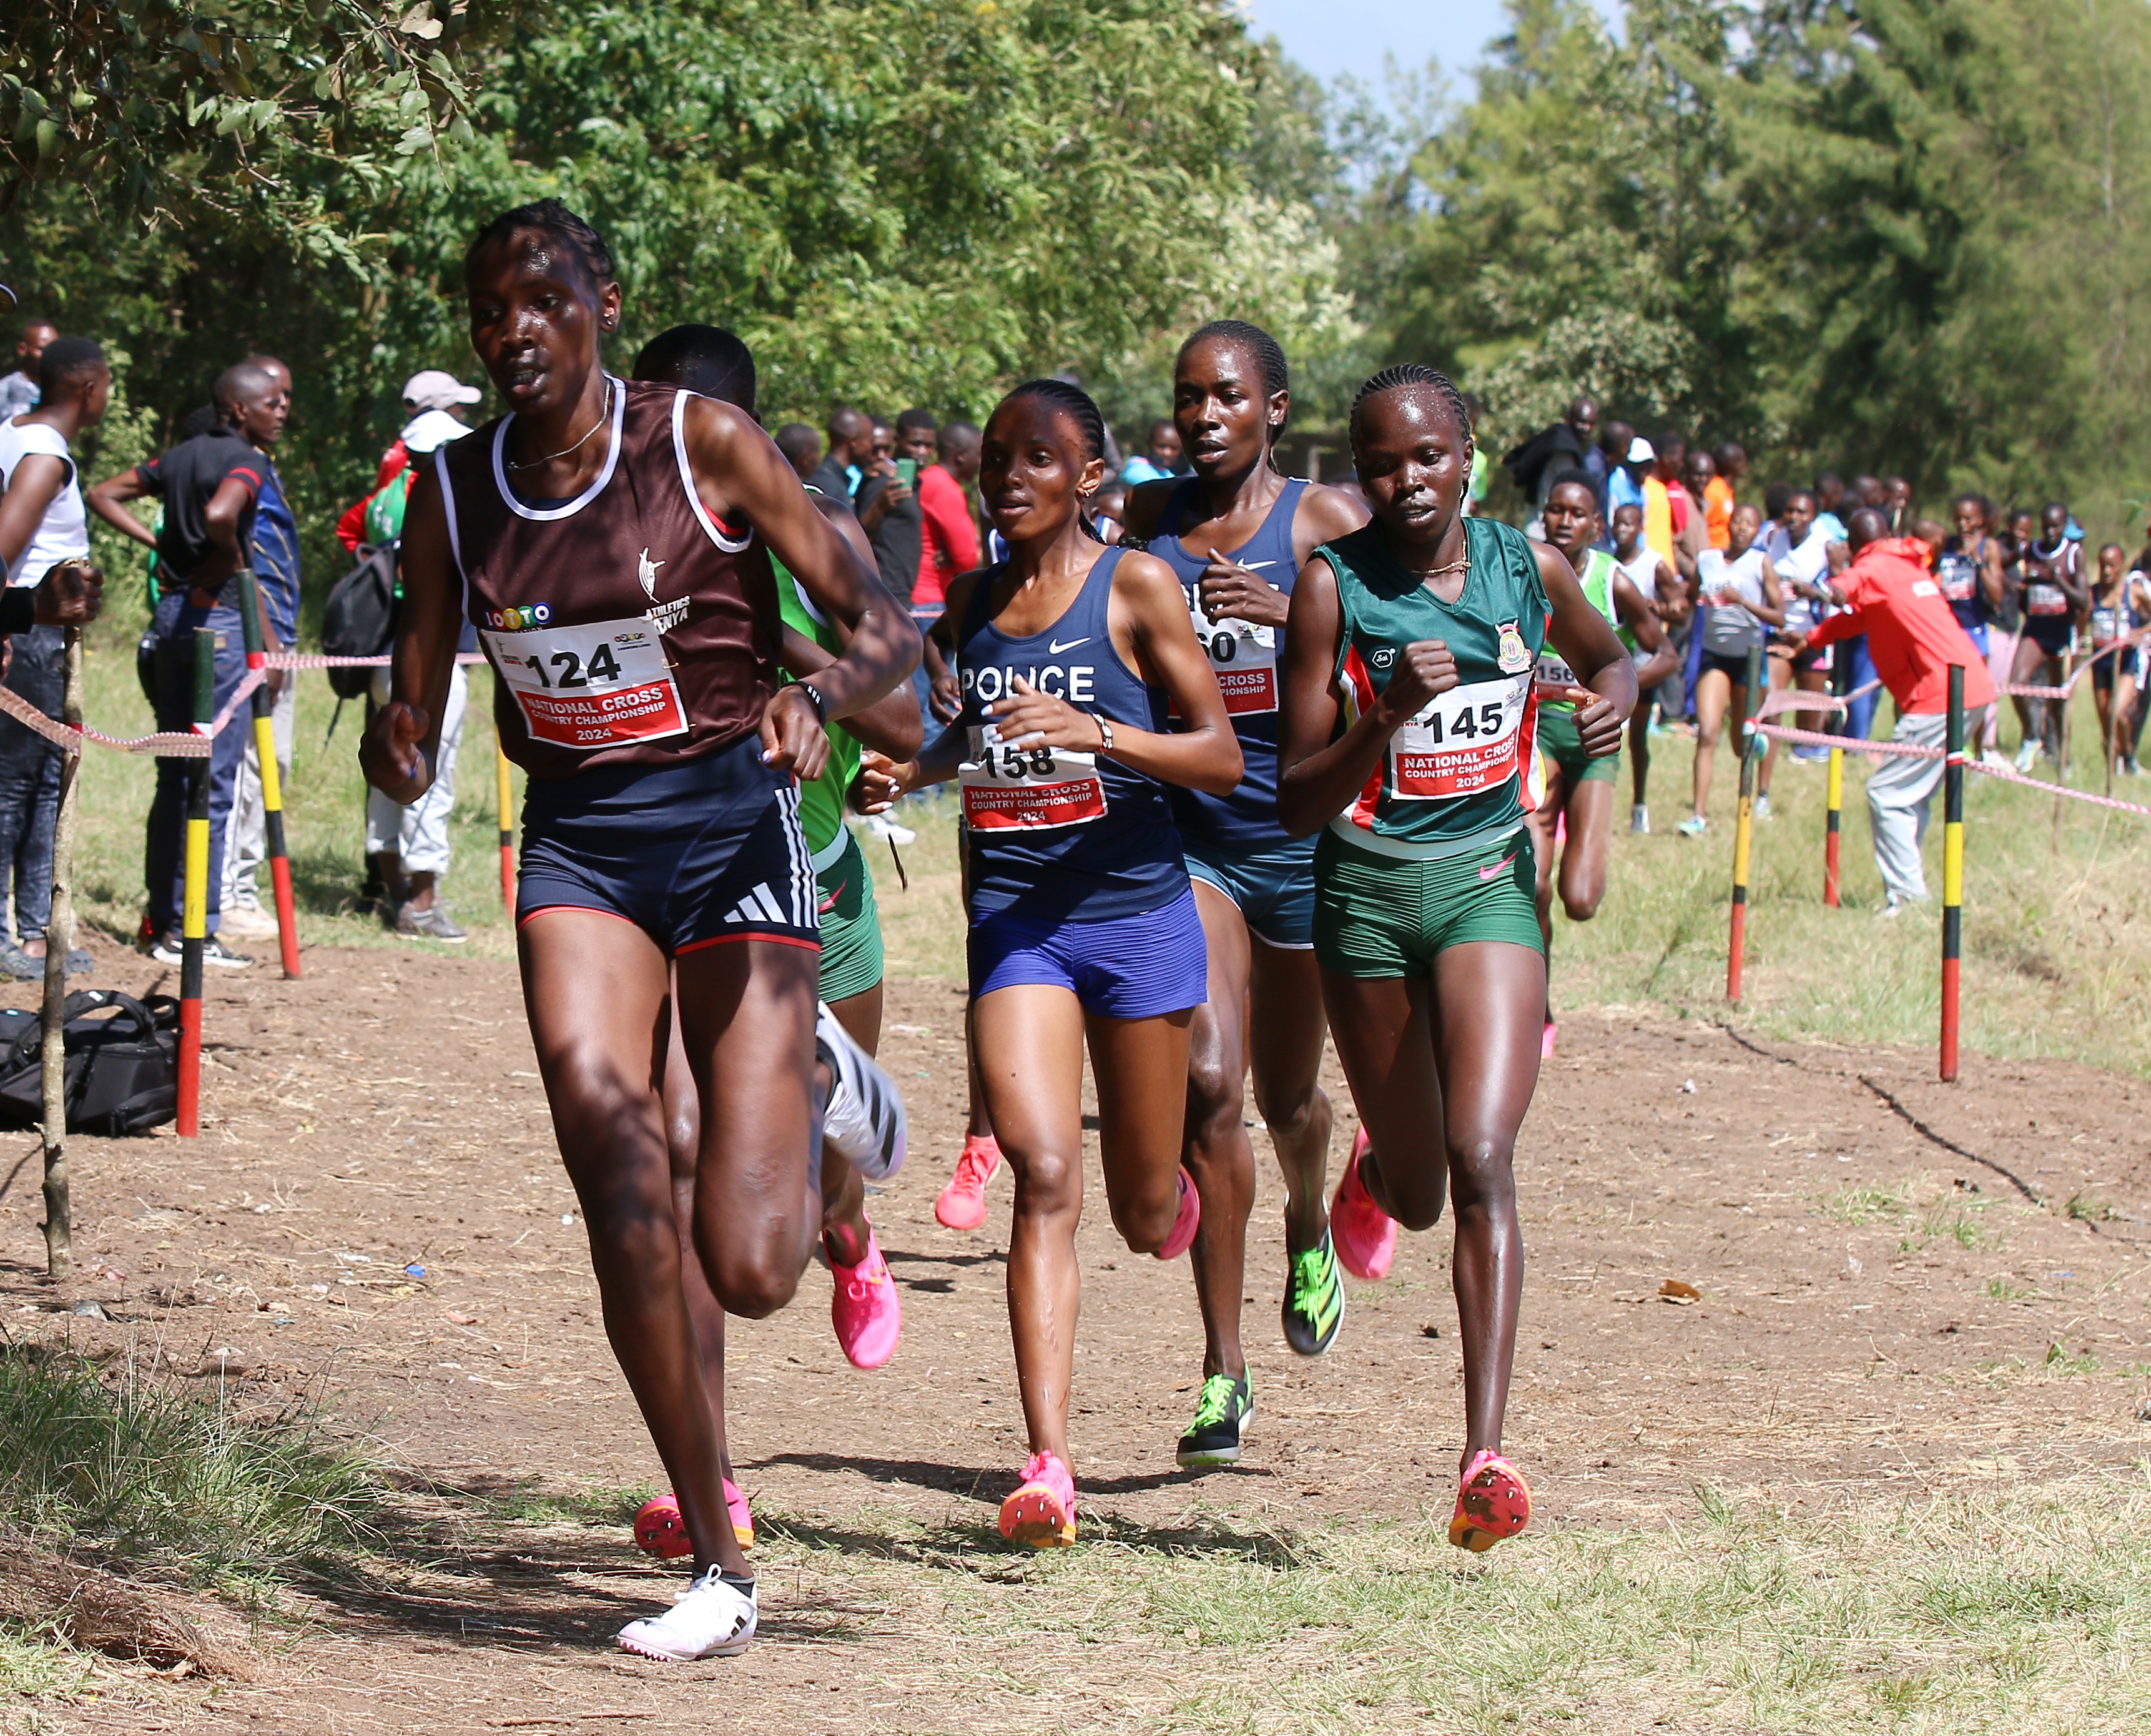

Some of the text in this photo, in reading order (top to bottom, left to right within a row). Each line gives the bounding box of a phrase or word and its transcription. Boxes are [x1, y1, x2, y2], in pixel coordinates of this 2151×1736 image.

[646, 595, 690, 619] ATHLETICS
[525, 643, 621, 688] 124
[1538, 665, 1575, 681] 156
[962, 665, 1095, 702] POLICE
[1219, 673, 1265, 686] CROSS
[1221, 686, 1266, 696] PIONSHIP
[524, 687, 663, 714] NATIONAL CROSS
[532, 701, 666, 726] COUNTRY CHAMPIONSHIP
[1424, 702, 1502, 744] 145
[576, 727, 613, 741] 2024
[980, 746, 1056, 779] 158
[1405, 733, 1515, 769] NATIONAL CROSS
[1405, 745, 1514, 778] COUNTRY CHAMPIONSHIP
[1456, 773, 1485, 788] 2024
[972, 792, 1092, 809] COUNTRY CHAMPIONSHIP
[1017, 811, 1046, 822] 2024
